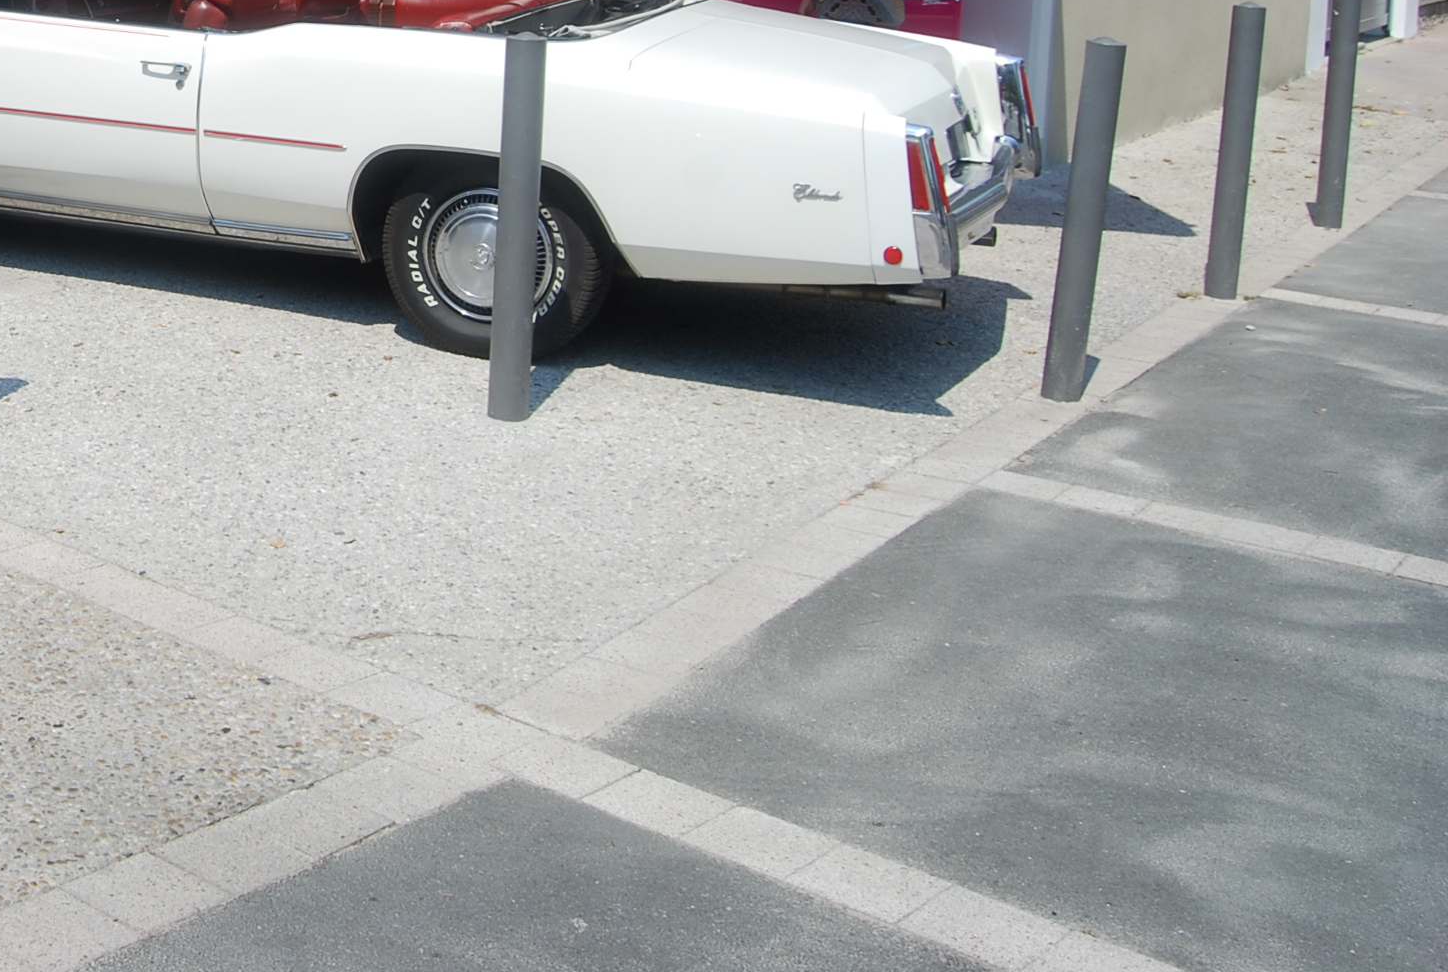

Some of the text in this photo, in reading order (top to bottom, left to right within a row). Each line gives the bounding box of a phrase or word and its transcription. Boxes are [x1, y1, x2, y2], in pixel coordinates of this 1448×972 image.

[407, 198, 439, 307] RADIAL G/T
[539, 202, 566, 260] OPER
